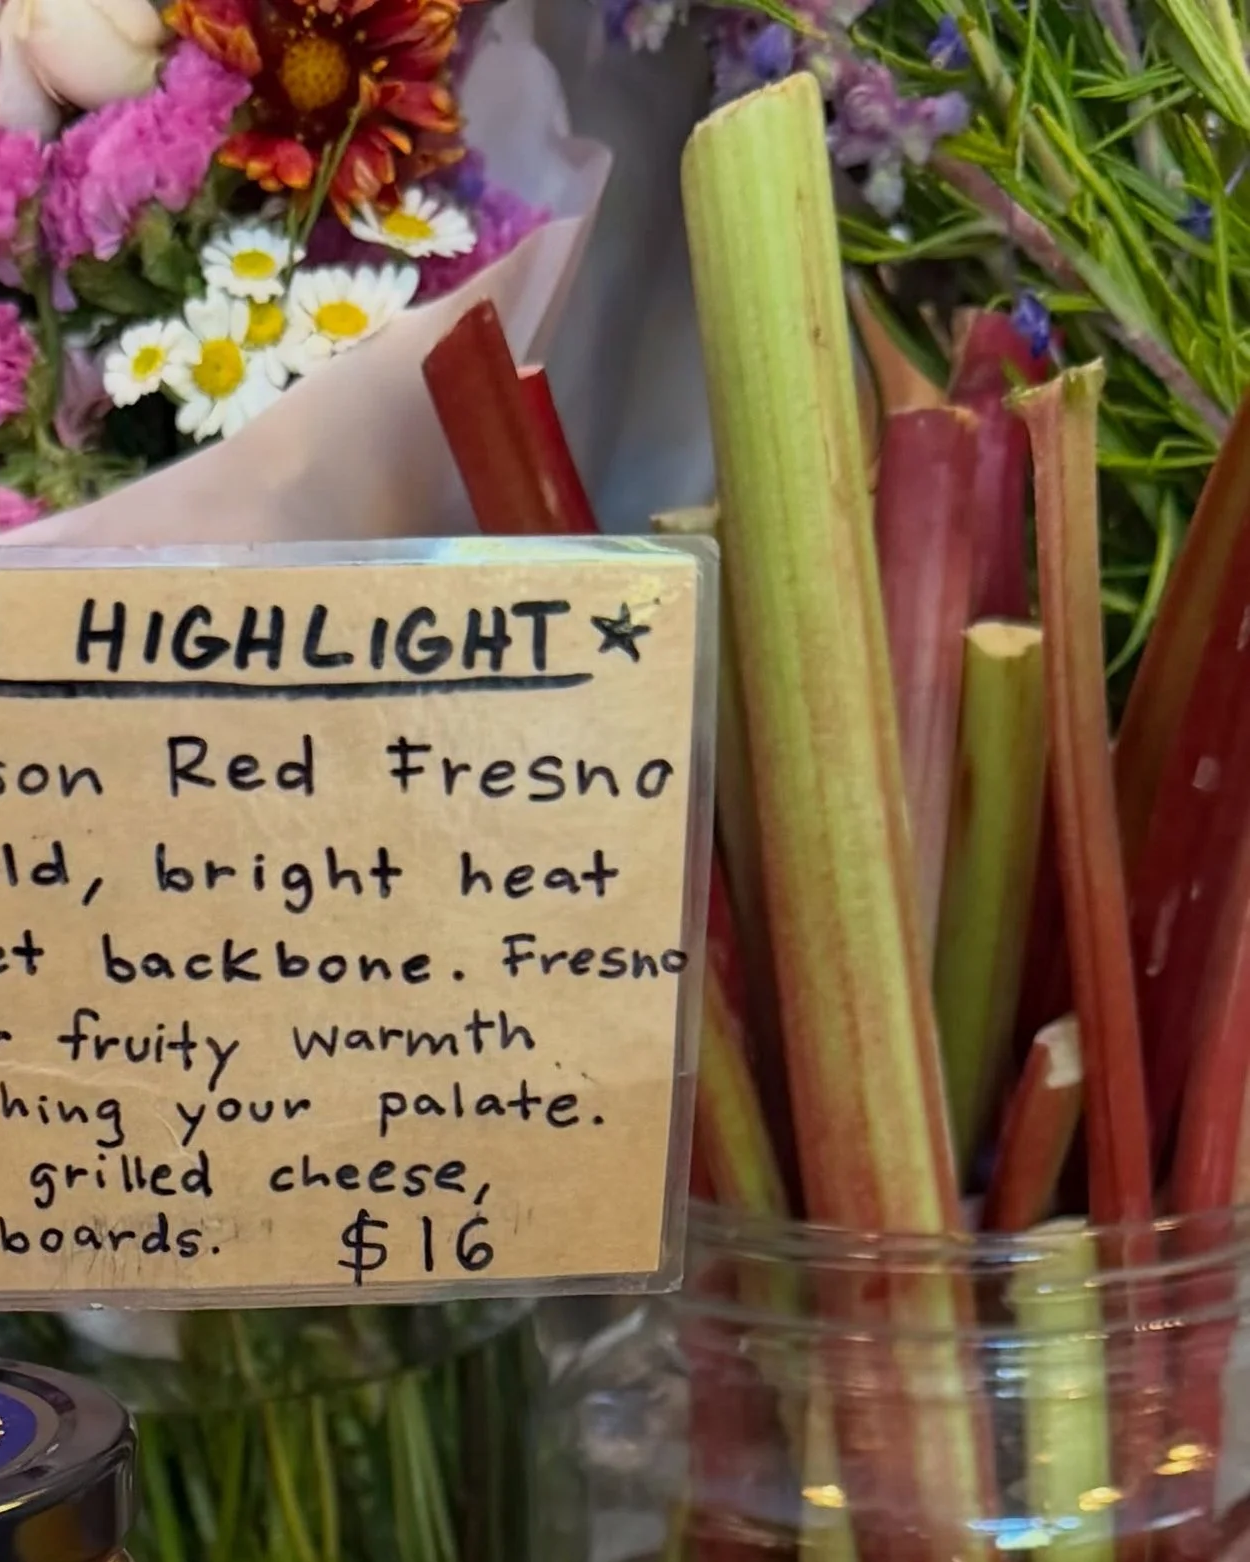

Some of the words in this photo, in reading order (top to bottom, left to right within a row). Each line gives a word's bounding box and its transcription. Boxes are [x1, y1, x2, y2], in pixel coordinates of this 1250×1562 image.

[77, 600, 574, 674] HIGHLIGHT
[167, 735, 318, 798] Red
[387, 735, 676, 800] Fresno
[154, 853, 406, 912] bright
[459, 850, 620, 898] heat
[104, 935, 467, 985] backbone.
[502, 934, 690, 980] Fresno
[57, 1005, 241, 1073] fruity
[292, 1005, 537, 1055] warmth
[175, 1093, 312, 1154] your
[379, 1082, 607, 1131] palate.
[29, 1152, 213, 1201] grilled
[269, 1154, 492, 1203] cheese,
[338, 1210, 497, 1286] $16
